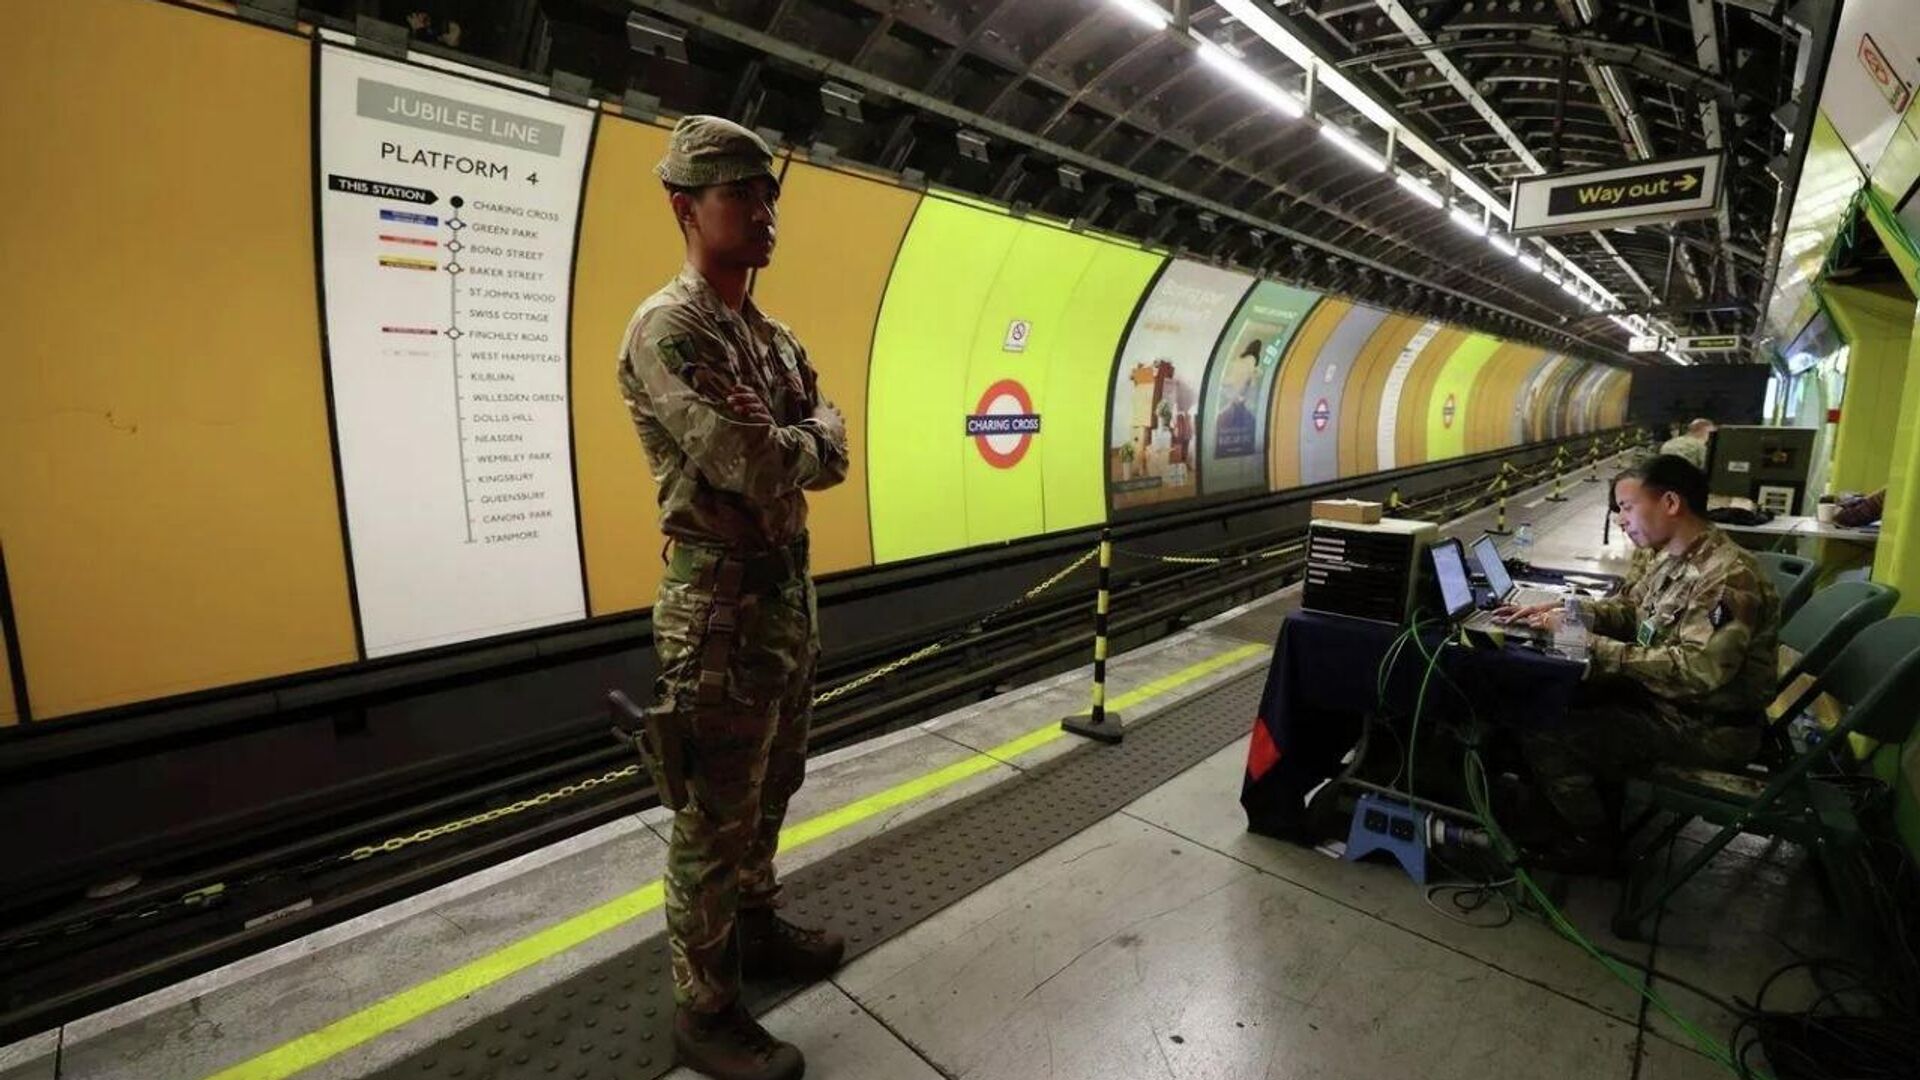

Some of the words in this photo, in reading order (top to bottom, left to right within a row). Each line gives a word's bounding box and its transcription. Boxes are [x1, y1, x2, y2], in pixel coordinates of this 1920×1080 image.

[387, 95, 484, 132] JUBILEE
[491, 119, 540, 144] LINE
[380, 141, 509, 181] PLATFORM
[525, 171, 539, 186] 4
[337, 178, 370, 194] THIS
[372, 184, 427, 202] STATION
[1579, 187, 1624, 204] Way
[1629, 180, 1669, 197] out
[472, 200, 524, 217] CHARING
[526, 208, 560, 221] CROSS
[471, 222, 510, 235] GREEN
[512, 228, 539, 239] PARK
[470, 244, 503, 256] BOND
[506, 249, 544, 261] STREET
[469, 266, 504, 278] BAKER
[506, 270, 544, 281] STREET
[523, 293, 556, 303] WOOD
[469, 308, 500, 319] SWISS
[503, 311, 548, 322] COTTAGE
[469, 330, 519, 341] FINCHLEY
[521, 332, 549, 343] ROAD
[471, 351, 499, 360] WEST
[501, 352, 561, 363] HAMPSTEAD
[471, 373, 515, 382] KILBURN
[473, 394, 529, 402] WILLESDEN
[532, 394, 564, 402] GREEN
[473, 414, 510, 423] DOLLIS
[513, 413, 534, 422] HILL
[968, 419, 1009, 432] CHARING
[1012, 418, 1038, 430] CROSS
[475, 434, 523, 443] NEASDEN
[477, 454, 525, 464] WEMBLEY
[528, 452, 552, 461] PARK
[478, 472, 534, 484] KINGSBURY
[480, 491, 545, 505] QUEENSBURY
[482, 513, 526, 524] CANONS
[529, 510, 552, 519] PARK
[484, 530, 539, 544] STANMORE
